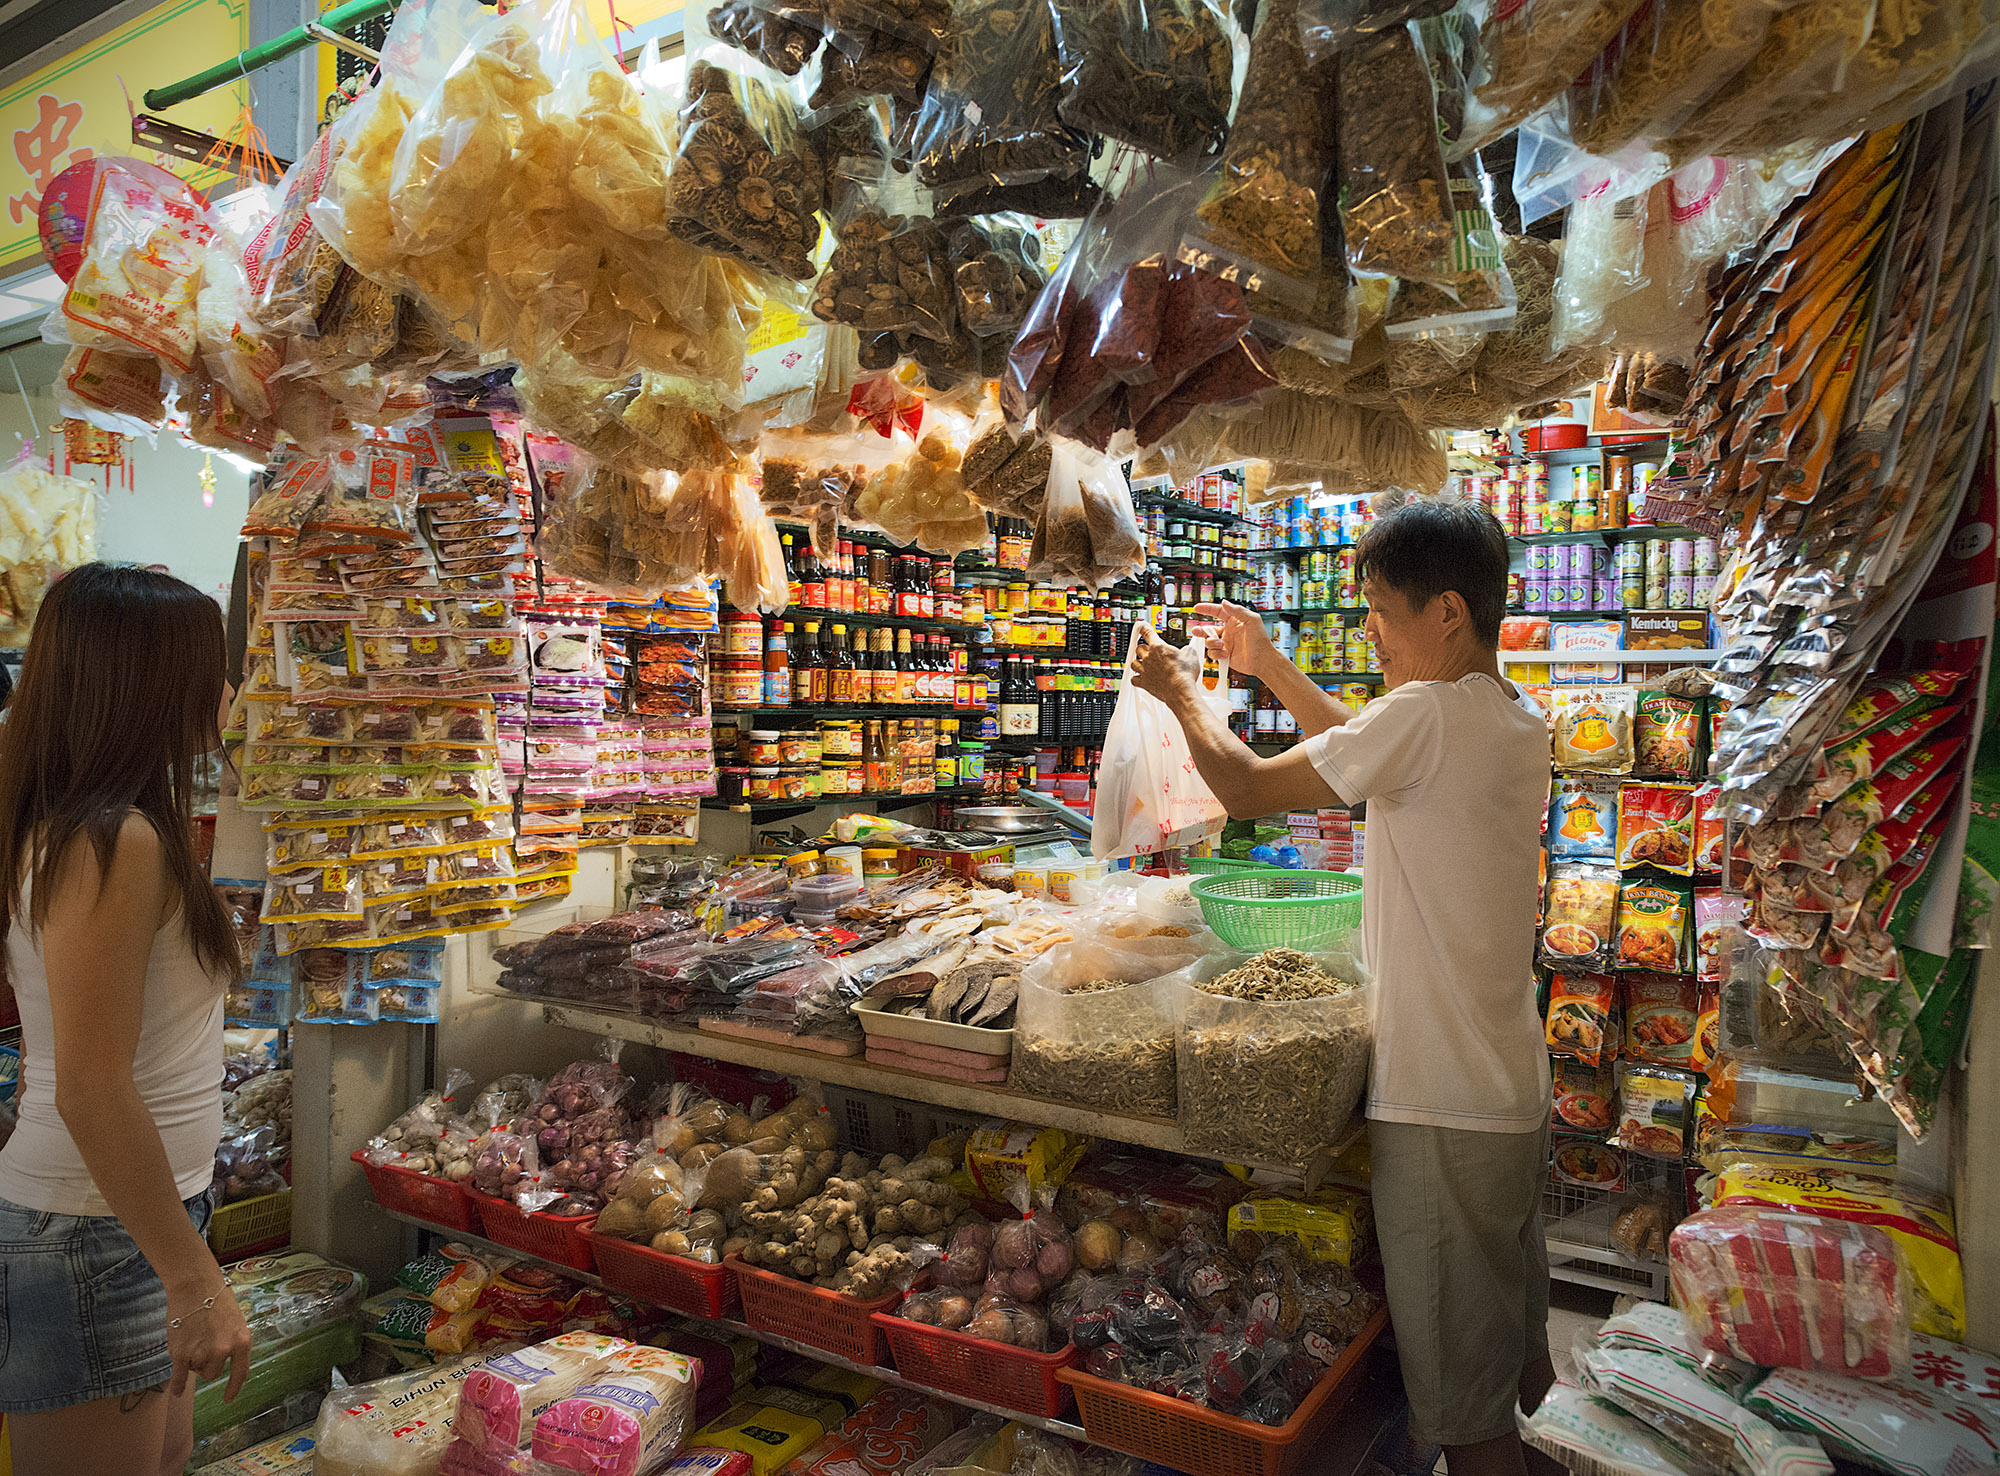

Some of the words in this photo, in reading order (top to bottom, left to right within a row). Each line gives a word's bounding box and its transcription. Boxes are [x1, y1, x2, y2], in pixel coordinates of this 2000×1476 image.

[100, 293, 139, 312] FRIED
[141, 305, 163, 321] PIG
[164, 318, 190, 341] SKIN
[1631, 617, 1678, 632] Kentucky
[1565, 636, 1606, 649] aloha
[1644, 699, 1664, 711] IKAN
[918, 855, 933, 867] XO
[988, 855, 1001, 865] XO
[1626, 890, 1646, 899] IKAN
[1649, 889, 1677, 903] BRAND
[388, 1378, 447, 1409] BIHUN
[531, 1404, 548, 1418] BICH
